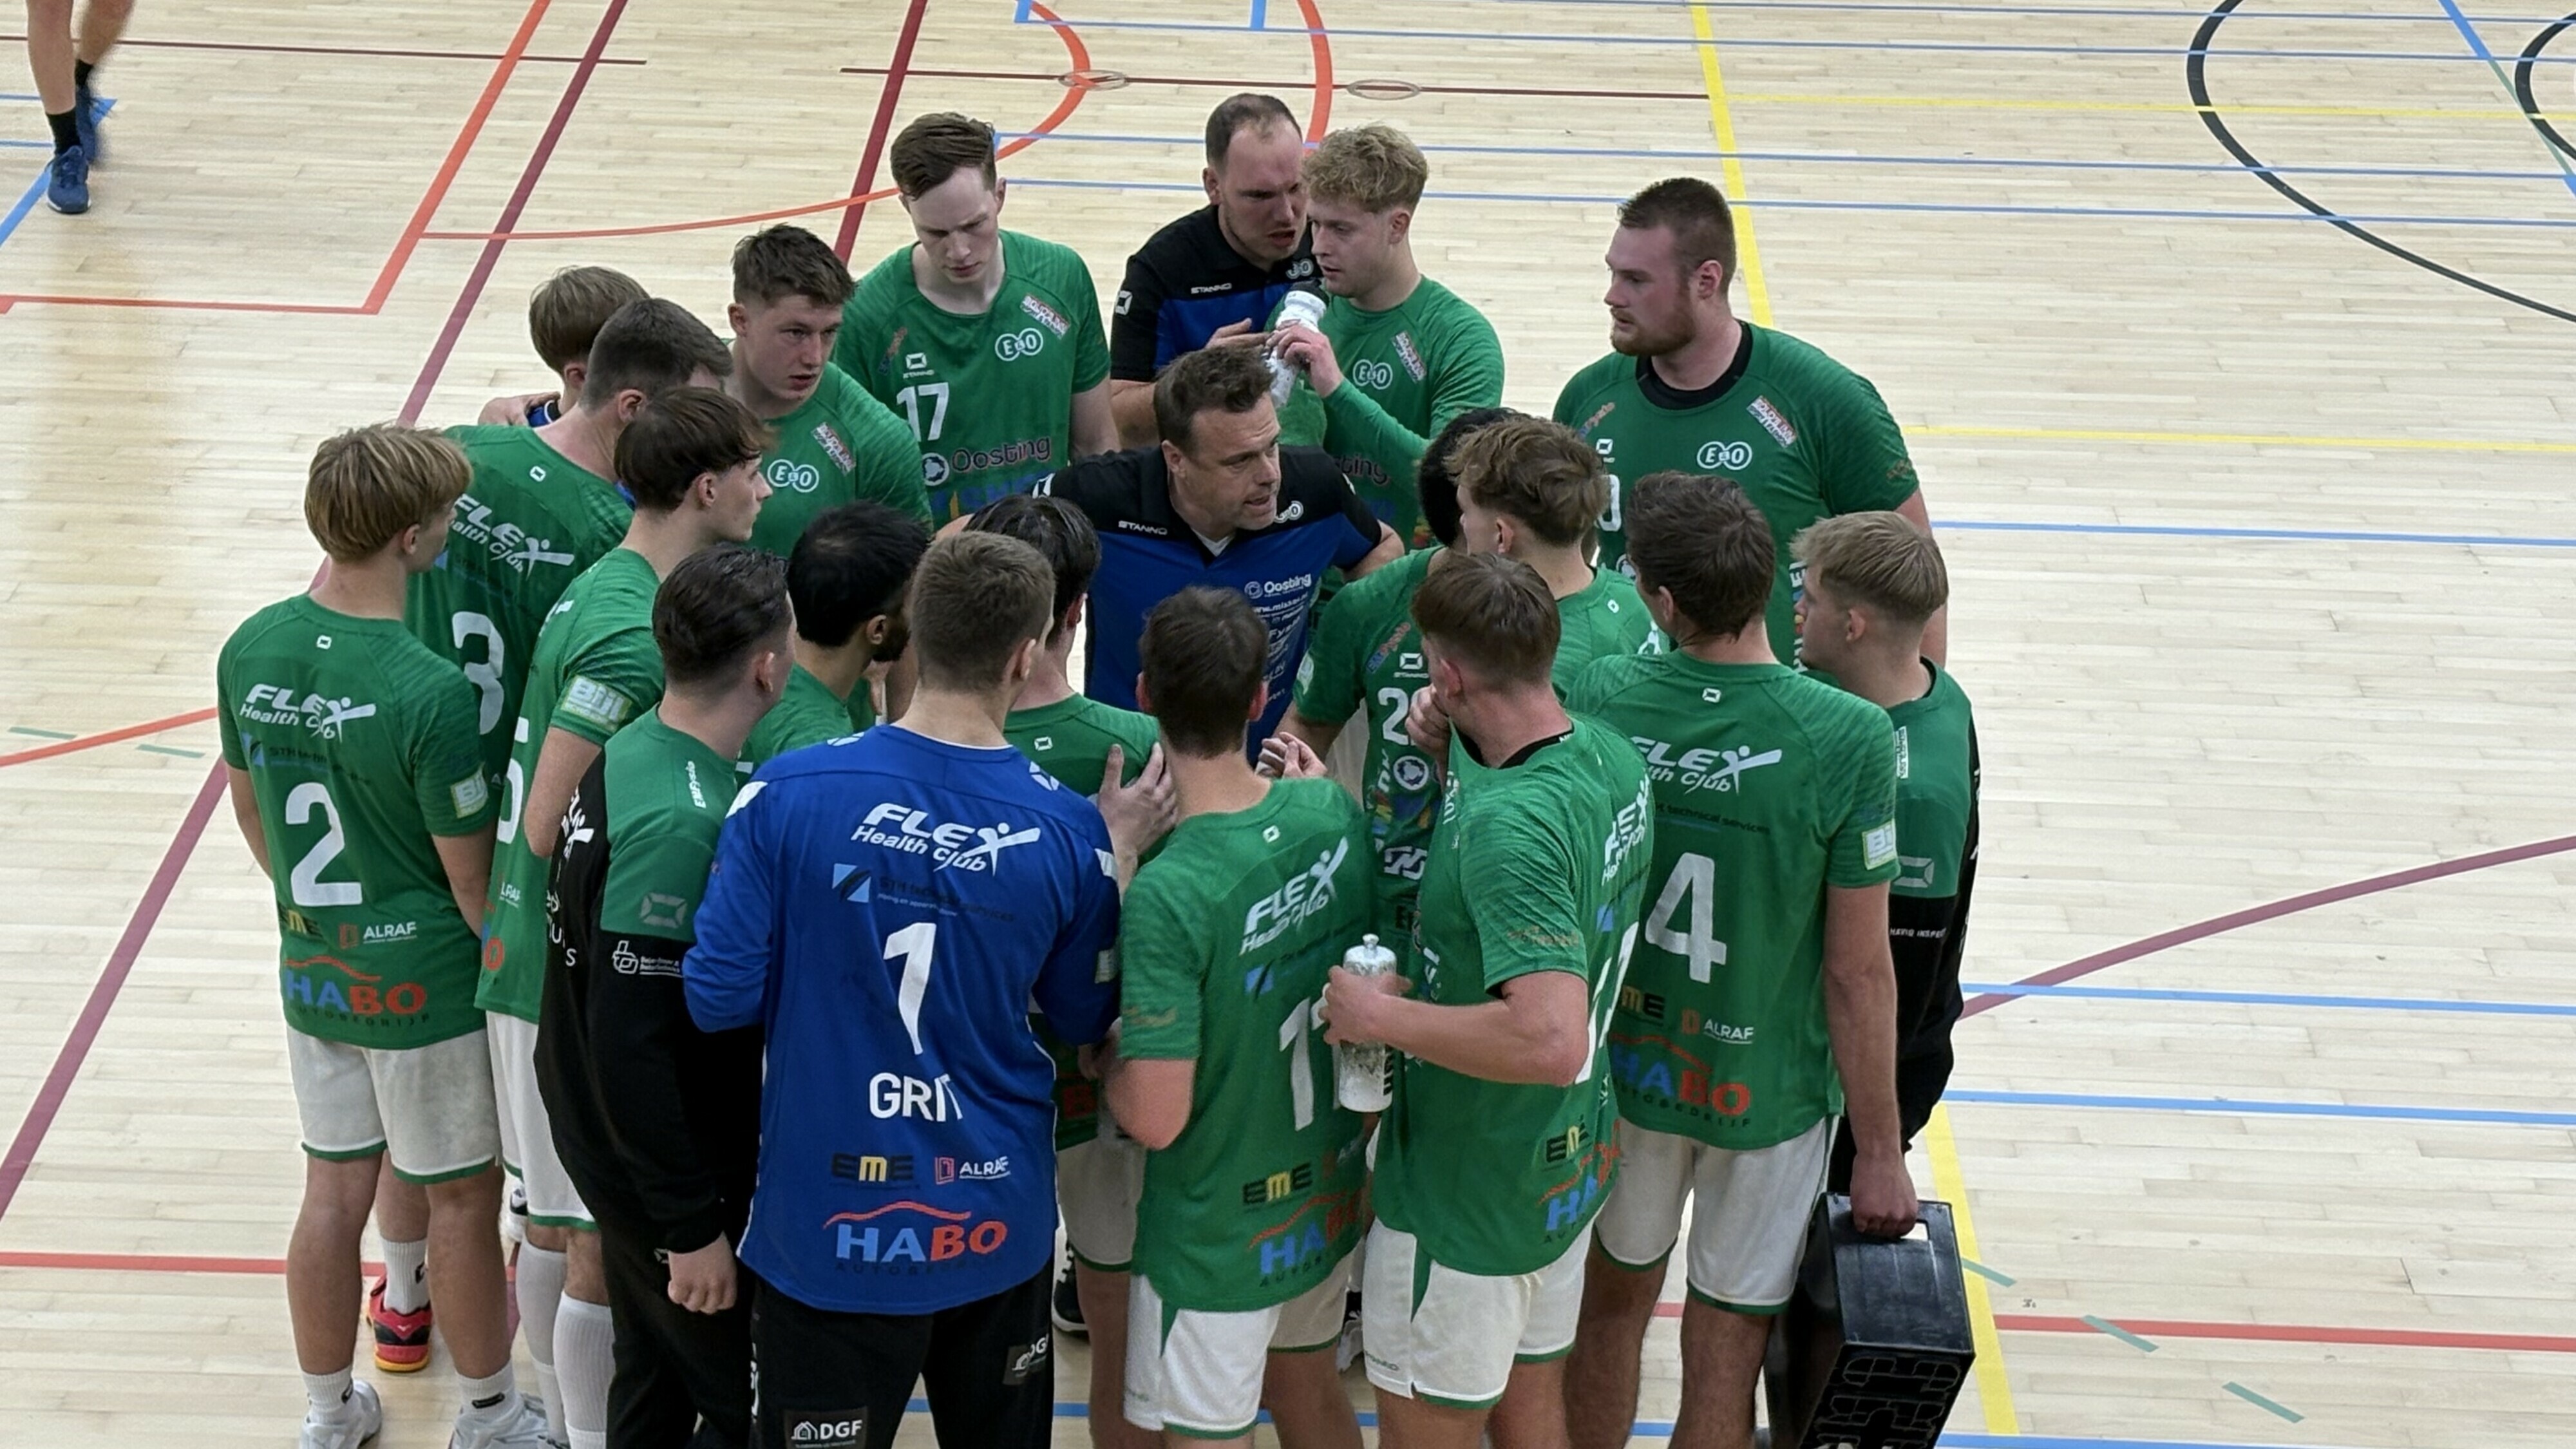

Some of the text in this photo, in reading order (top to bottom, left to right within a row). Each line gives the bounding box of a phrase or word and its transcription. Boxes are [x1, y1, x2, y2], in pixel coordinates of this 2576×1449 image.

[896, 381, 950, 442] 17
[951, 435, 1053, 473] Oosting
[451, 520, 489, 545] alth
[1117, 519, 1168, 536] STANNO
[239, 703, 300, 726] Health
[245, 683, 377, 743] FLEX
[1378, 687, 1421, 746] 2
[1680, 772, 1732, 795] Club
[285, 782, 363, 907] 2
[850, 825, 987, 872] Health Club
[862, 802, 1041, 876] FLEX
[1244, 836, 1349, 936] FLEX
[362, 920, 418, 940] ALRAF
[1645, 851, 1727, 984] 4
[283, 967, 427, 1016] HABO
[882, 922, 937, 1056] 1
[1704, 1018, 1754, 1041] ALRAF
[1612, 1043, 1751, 1116] HABO
[959, 1156, 1009, 1176] ALRAF
[836, 1220, 1008, 1263] HABO
[819, 1419, 864, 1441] DGF
